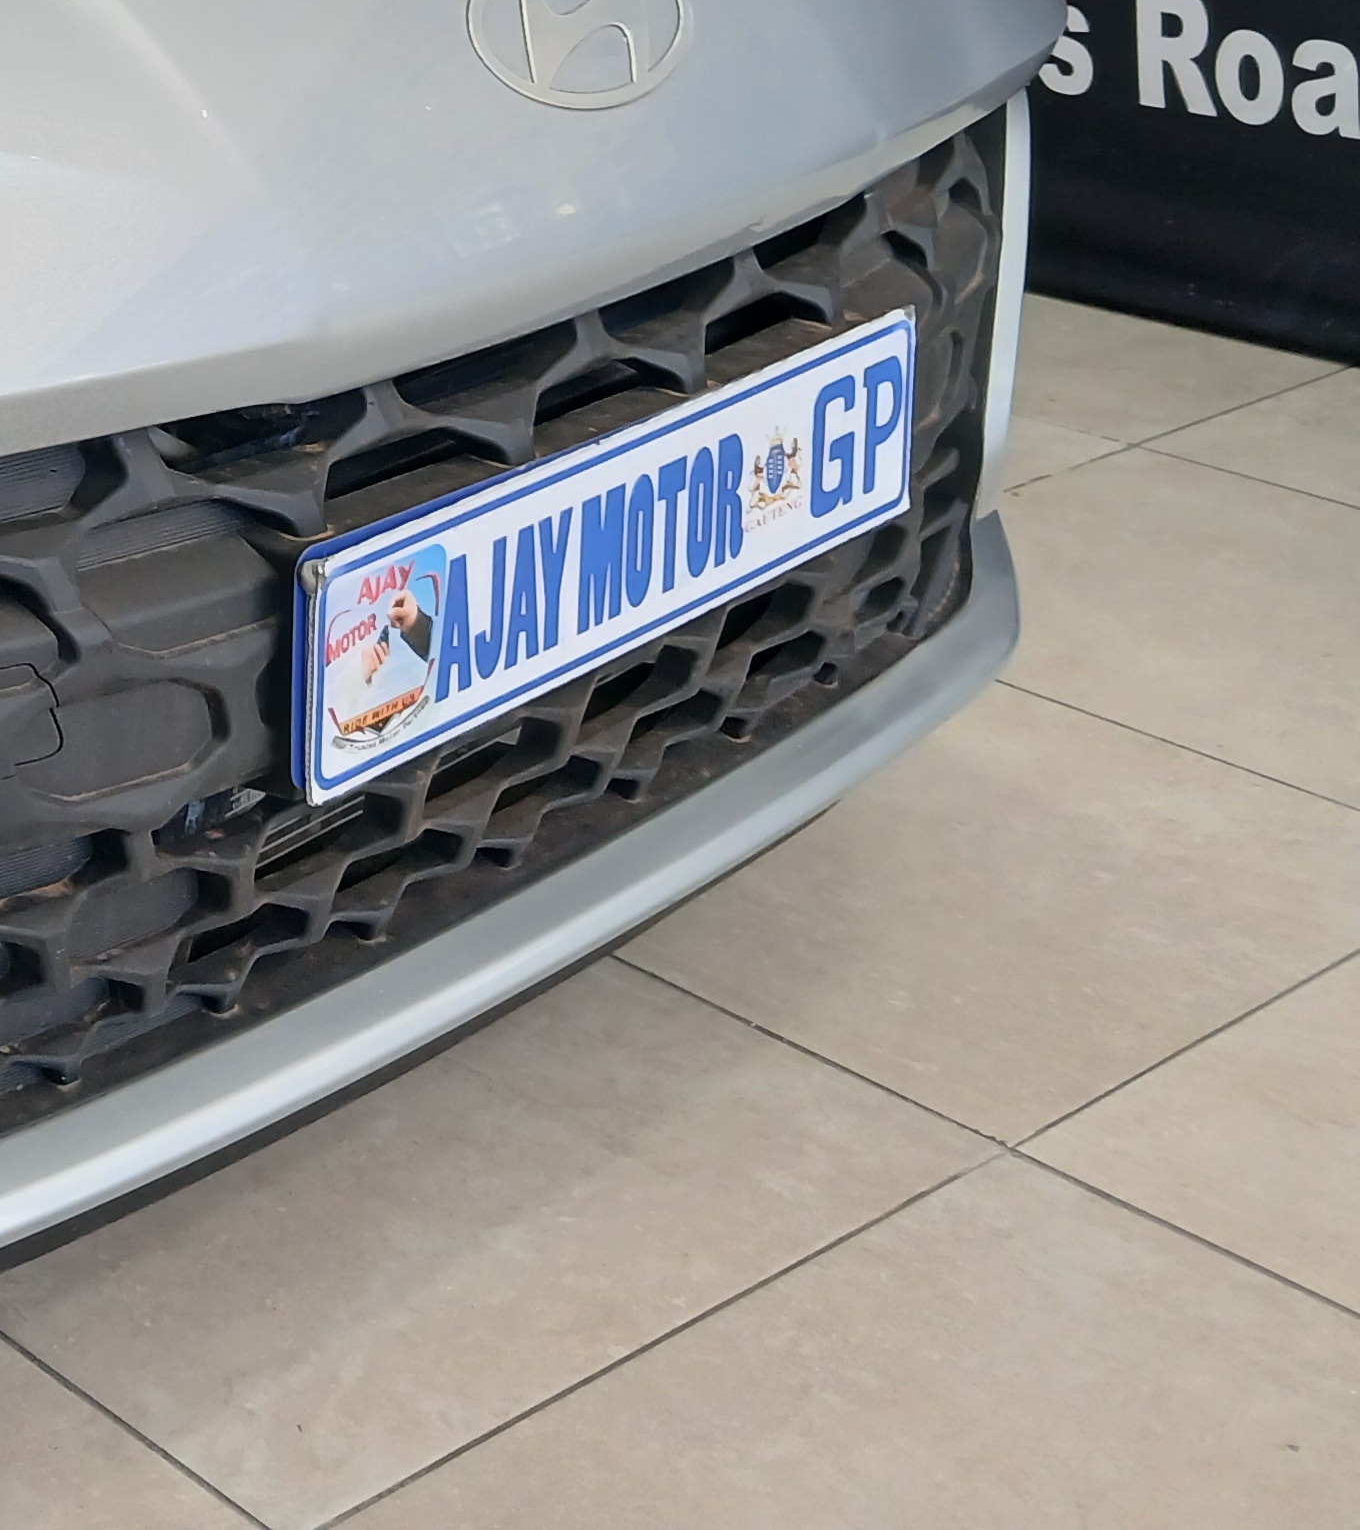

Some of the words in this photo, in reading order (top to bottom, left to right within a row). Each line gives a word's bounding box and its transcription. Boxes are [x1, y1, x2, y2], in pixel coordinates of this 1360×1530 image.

[434, 506, 573, 703] AJAY
[577, 432, 745, 636] MOTOR
[808, 355, 904, 519] GP
[744, 496, 803, 534] GAUTENG
[357, 559, 416, 605] AJAY
[325, 612, 378, 667] MOTOR
